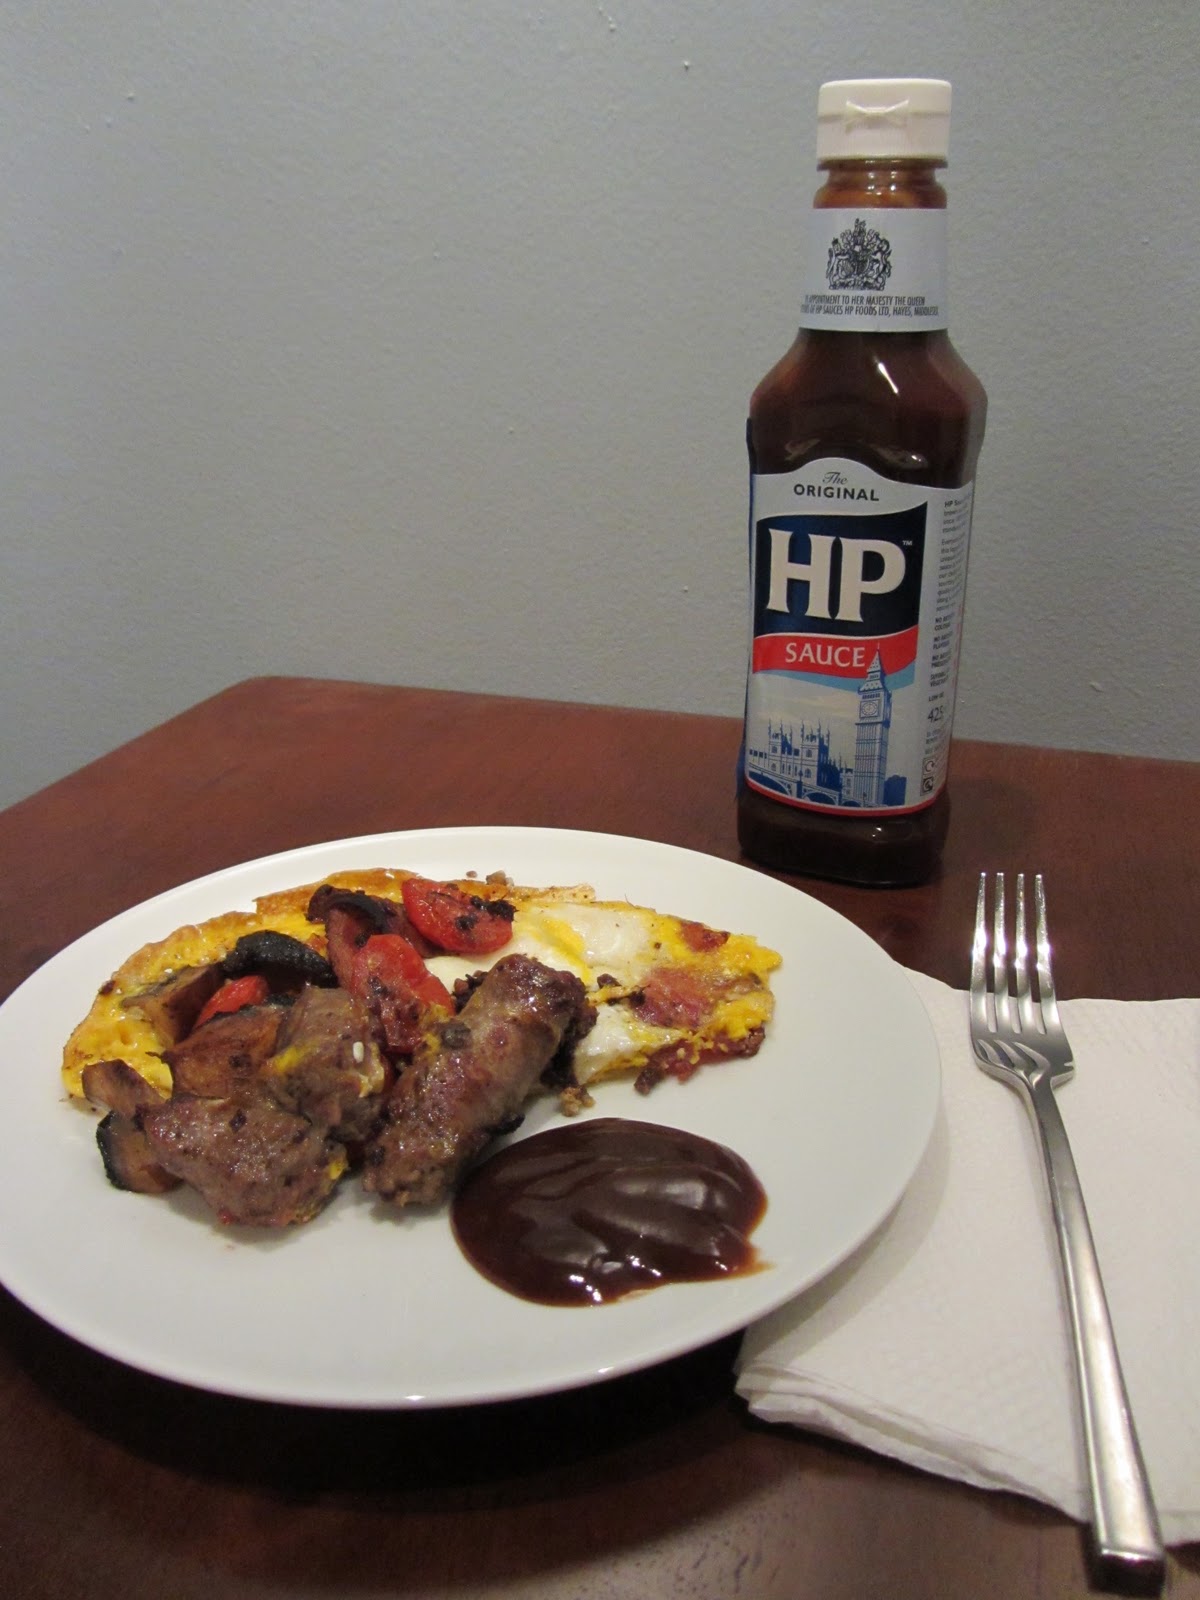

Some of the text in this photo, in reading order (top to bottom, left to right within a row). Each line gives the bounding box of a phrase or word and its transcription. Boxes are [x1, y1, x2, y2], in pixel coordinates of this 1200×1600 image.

[842, 295, 850, 304] TO
[852, 295, 865, 305] HER
[866, 296, 893, 306] MAJESTY
[895, 296, 906, 306] THE
[907, 296, 926, 306] QUEEN
[823, 305, 843, 315] SAUCES
[845, 305, 854, 315] HP
[855, 305, 877, 316] FOODS
[822, 471, 848, 485] The
[793, 483, 879, 501] ORIGINAL
[766, 528, 906, 622] HP
[785, 642, 865, 667] SAUCE
